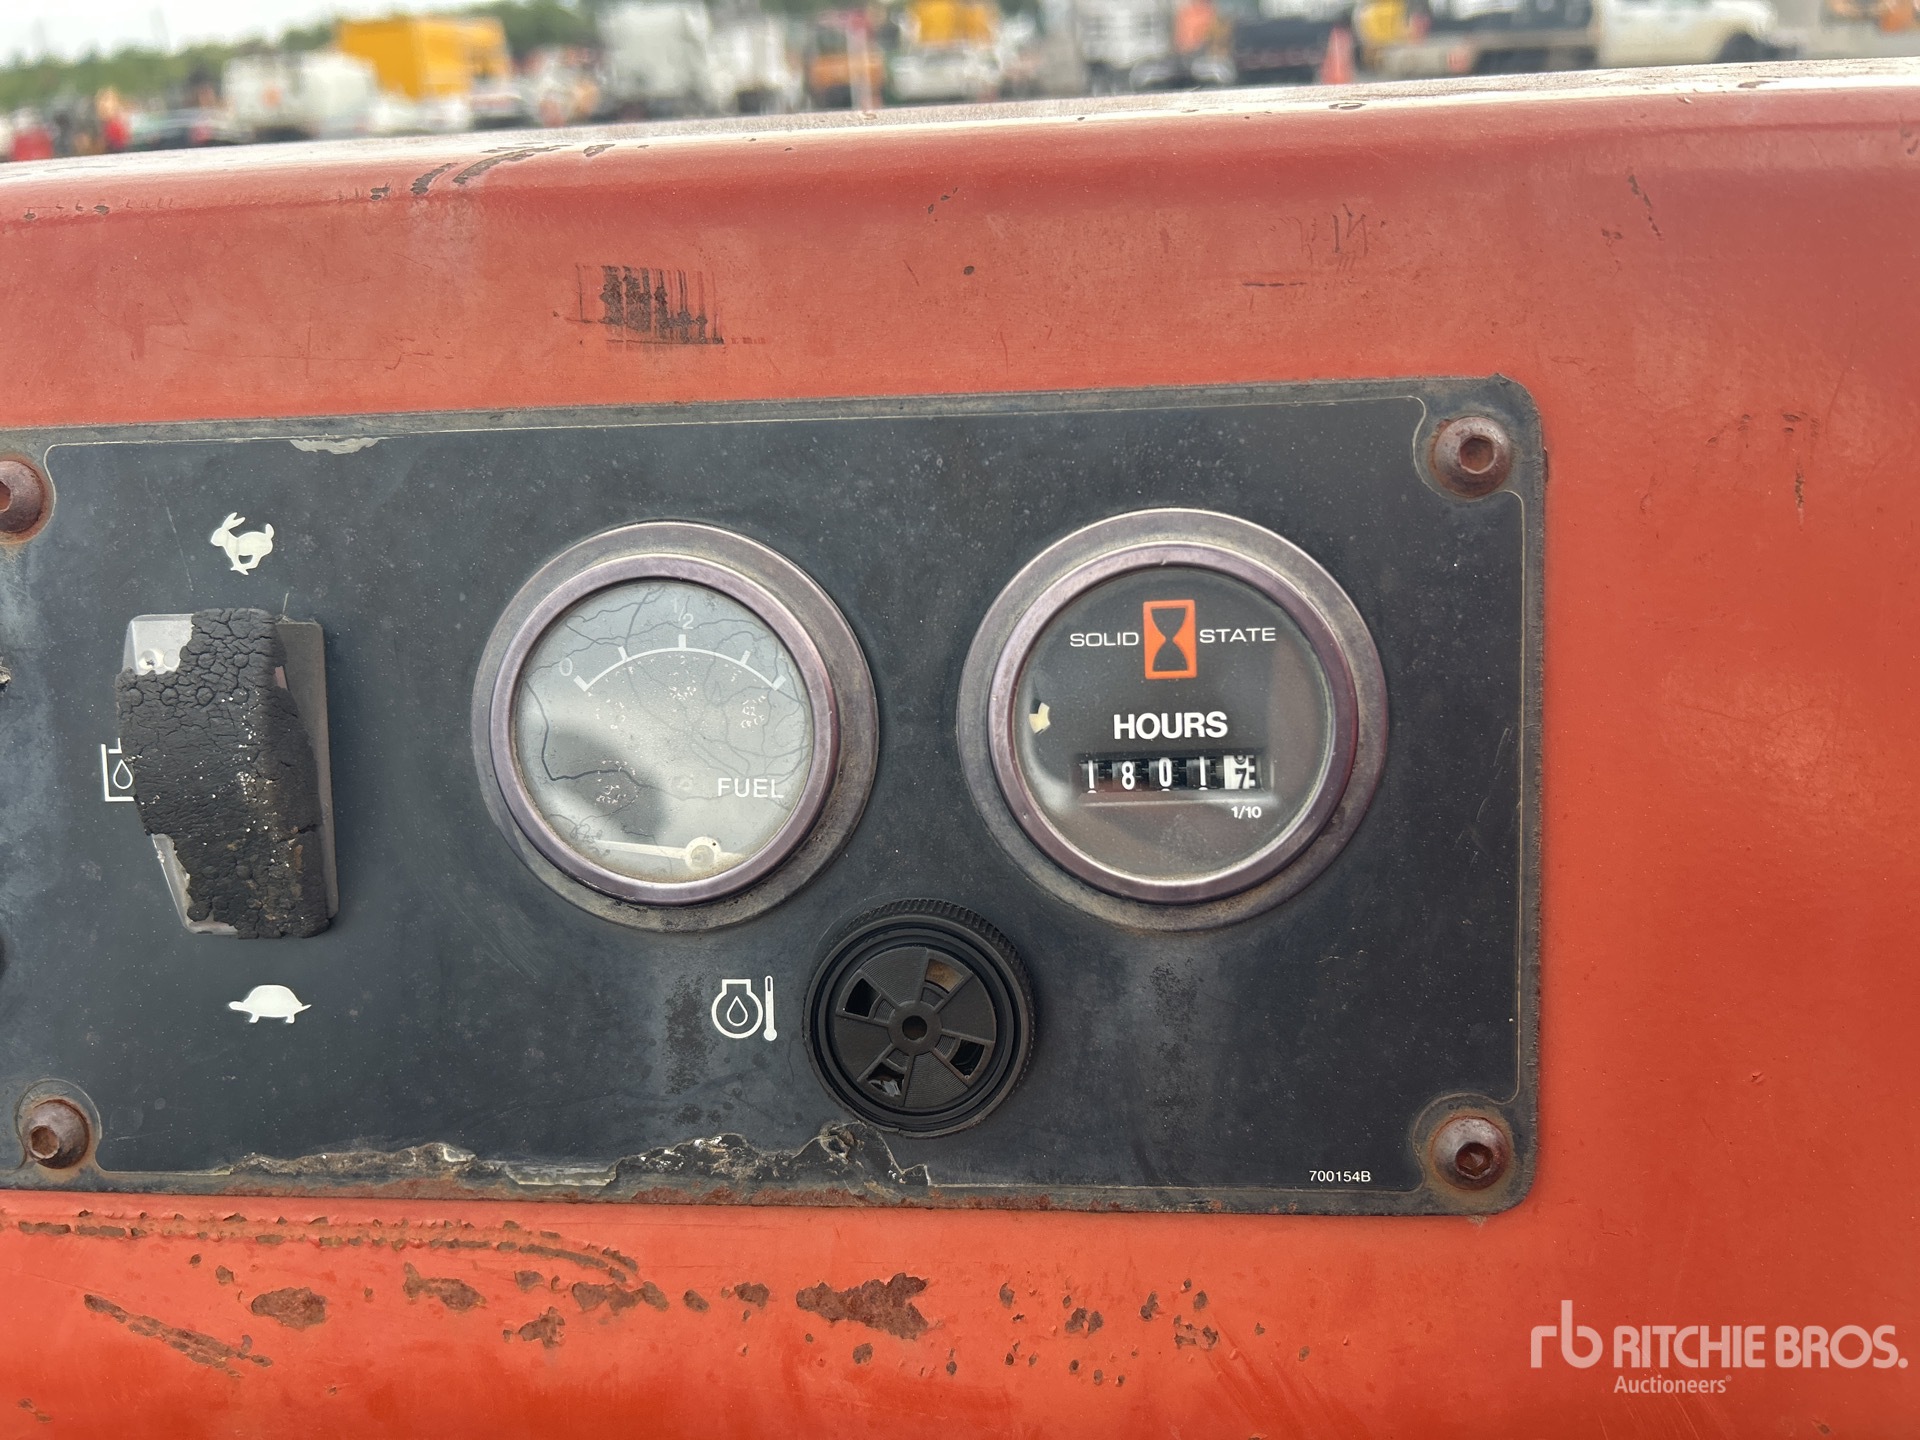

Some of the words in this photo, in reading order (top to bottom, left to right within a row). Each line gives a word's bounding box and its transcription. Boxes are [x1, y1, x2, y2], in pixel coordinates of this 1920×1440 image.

[1070, 632, 1140, 647] SOLID
[1199, 627, 1276, 643] STATE
[1113, 711, 1228, 740] HOURS
[717, 777, 785, 799] FUEL
[1230, 805, 1262, 819] 1/10
[1309, 1170, 1371, 1182] 700154B
